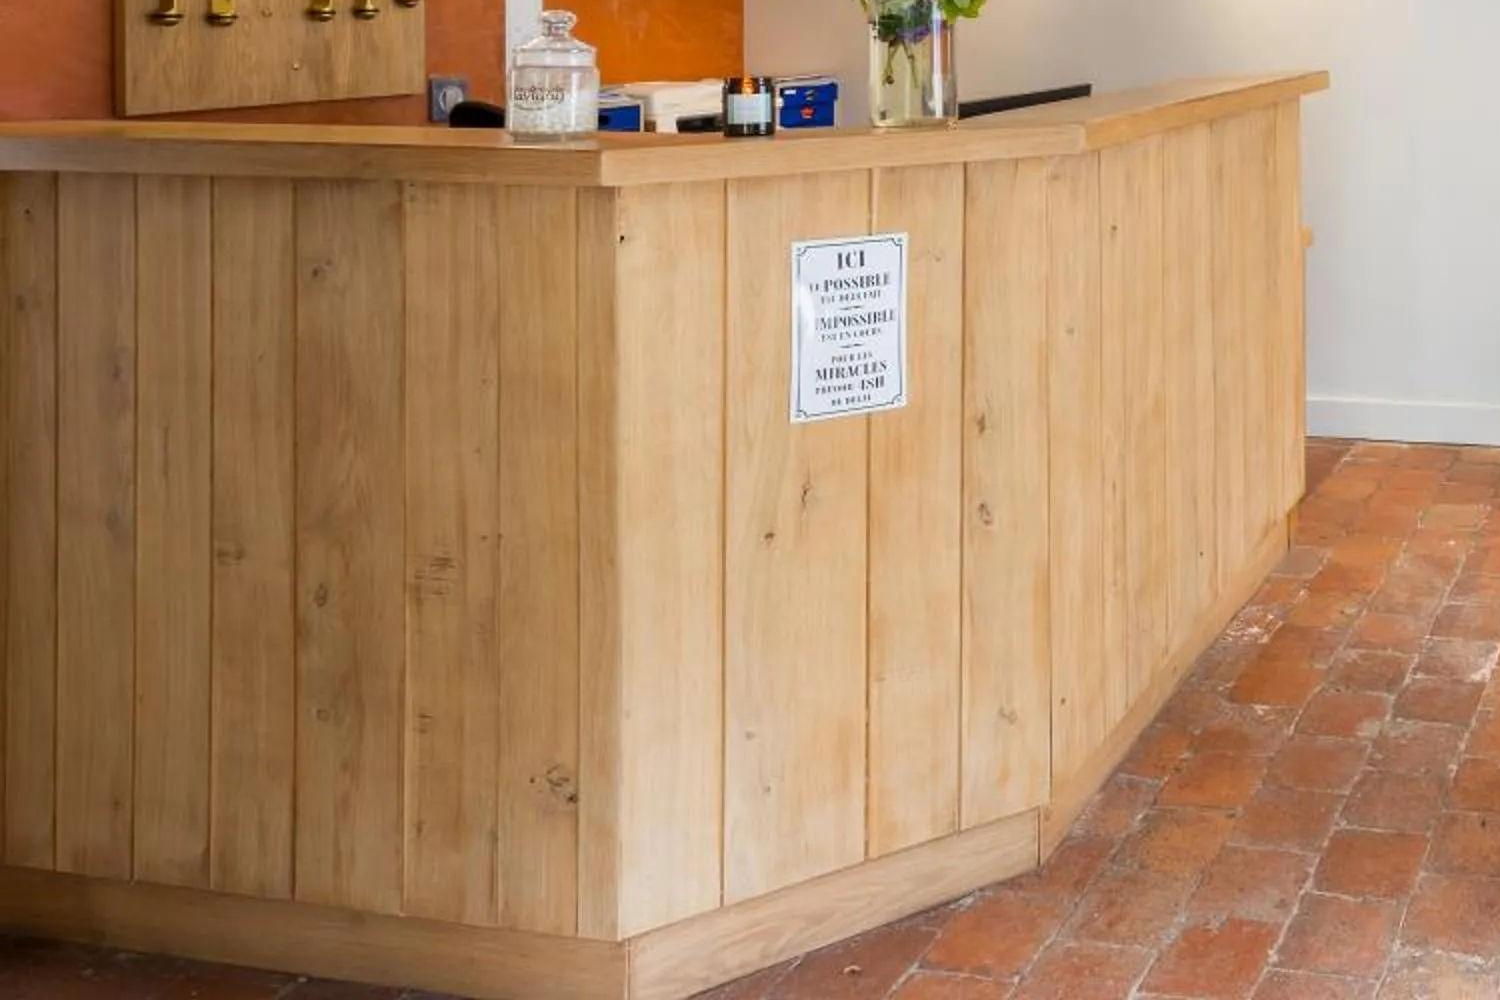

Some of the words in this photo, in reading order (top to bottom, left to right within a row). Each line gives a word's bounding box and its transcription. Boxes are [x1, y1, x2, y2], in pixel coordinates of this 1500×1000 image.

[837, 249, 865, 270] ICI
[823, 272, 890, 292] POSSIBLE
[815, 360, 887, 383] MIRACLES
